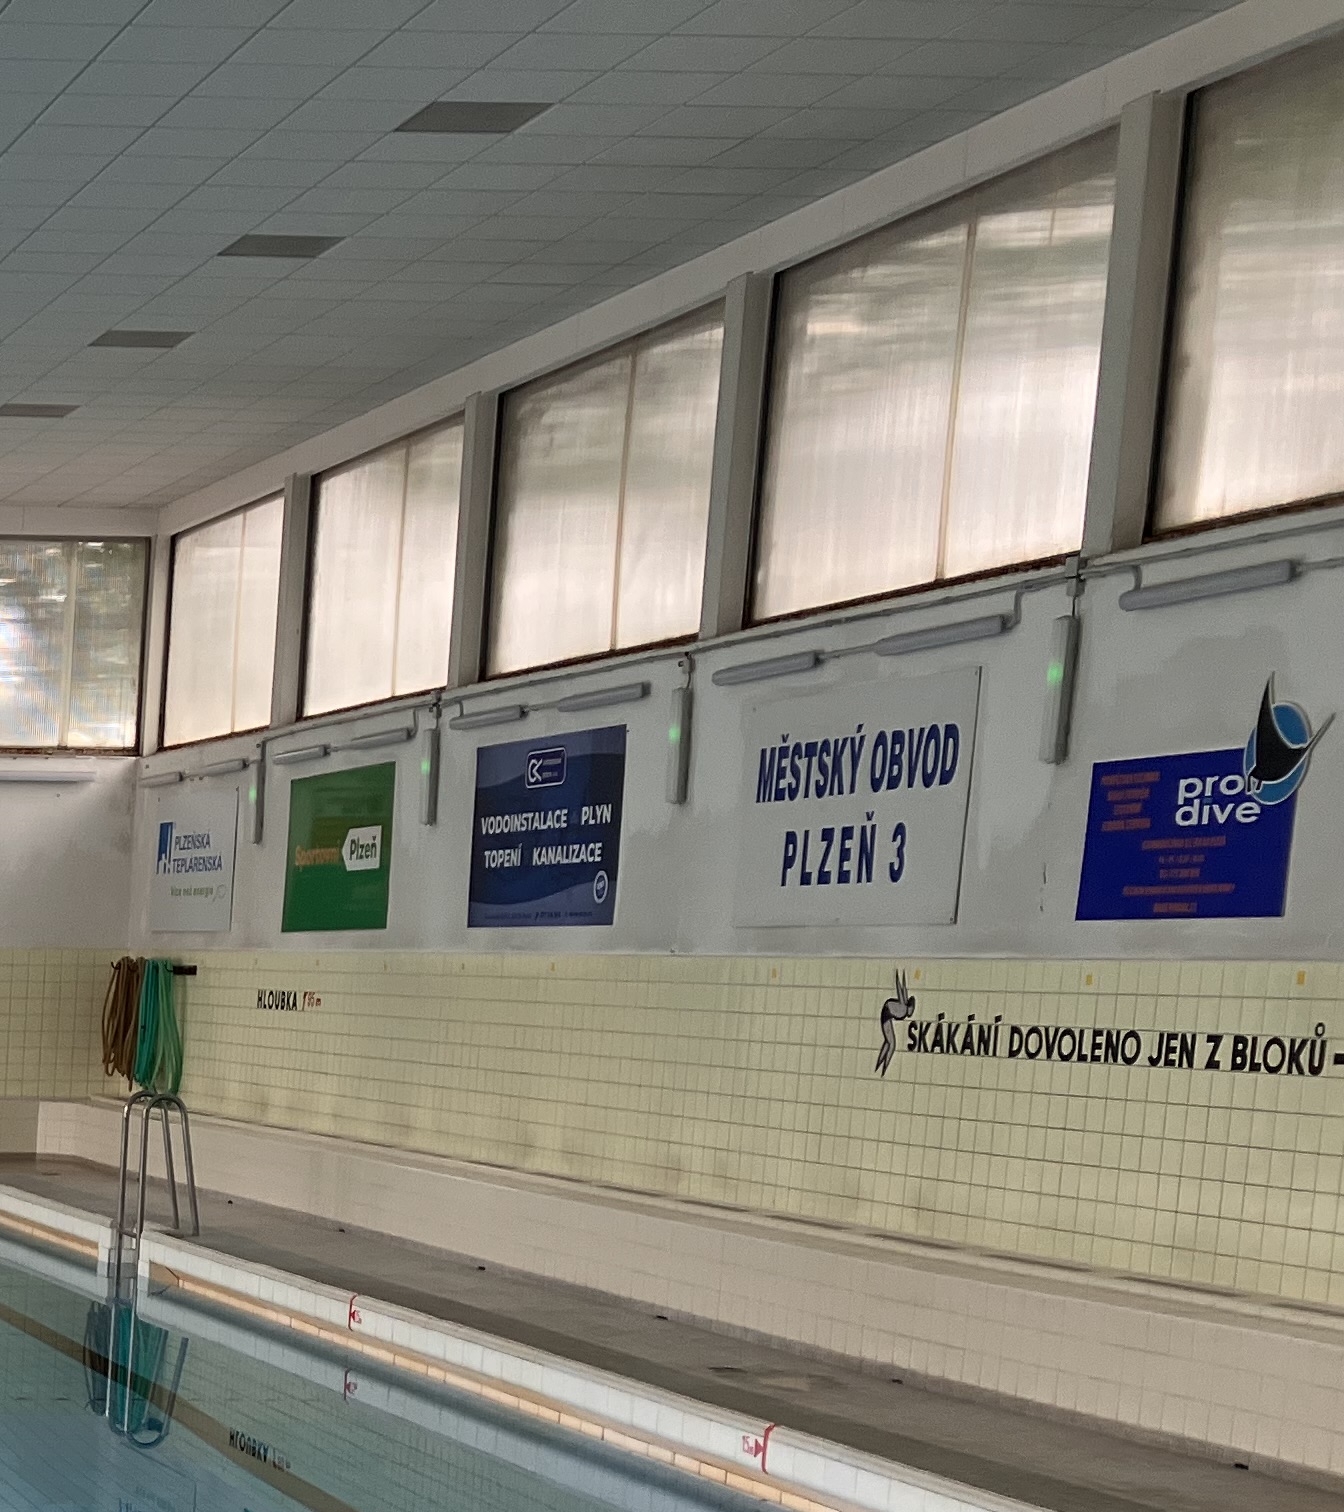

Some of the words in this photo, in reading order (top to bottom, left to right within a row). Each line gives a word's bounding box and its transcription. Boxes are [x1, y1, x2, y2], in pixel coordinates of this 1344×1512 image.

[756, 723, 866, 803] MĚSTSKÝ
[870, 723, 960, 793] OBVOD
[481, 808, 568, 835] VODOINSTALACE
[581, 803, 612, 826] PLYN
[1175, 798, 1261, 827] dive
[349, 835, 377, 861] Plzeň
[484, 843, 523, 869] TOPENÍ
[532, 842, 603, 866] KANALIZACE
[780, 810, 877, 887] PLZEŇ
[889, 822, 907, 883] 3
[256, 989, 297, 1011] HLOUBKA
[906, 1012, 1002, 1057] SKÁKÁNÍ
[1008, 1026, 1142, 1066] DOVOLENO
[1148, 1032, 1197, 1069] JEN
[1205, 1036, 1221, 1070] Z
[1230, 1022, 1328, 1077] BLOKŮ
